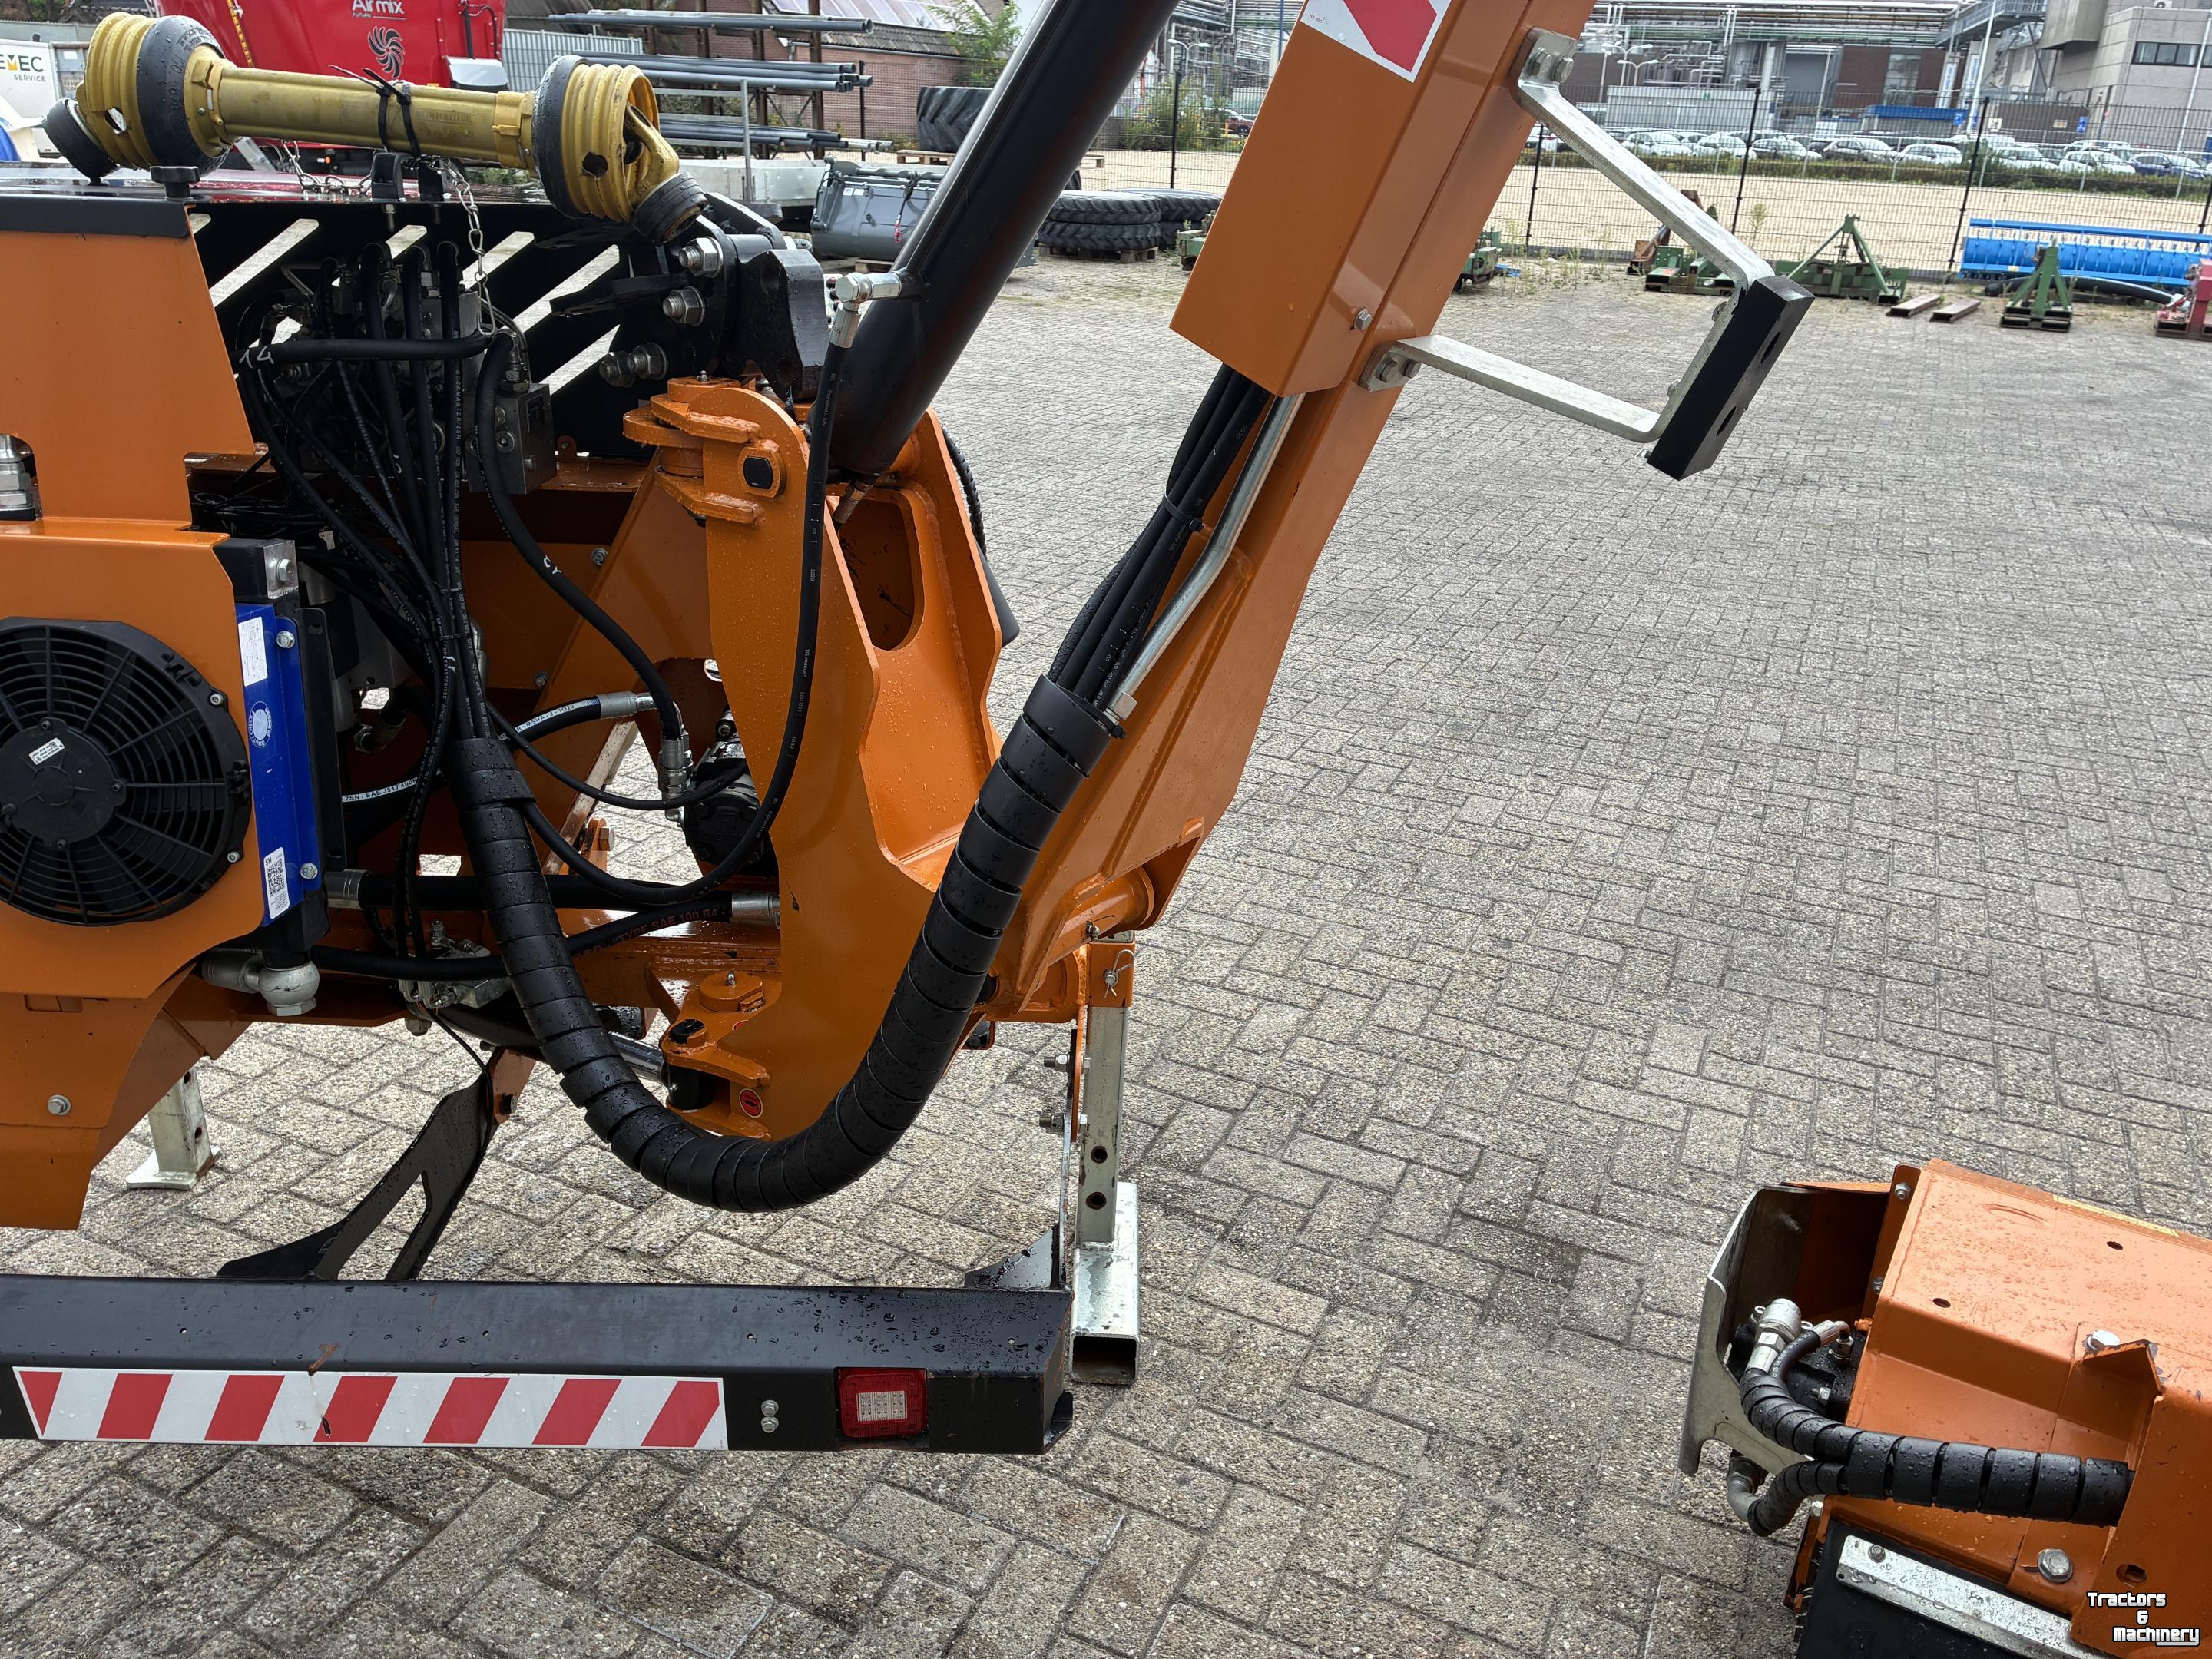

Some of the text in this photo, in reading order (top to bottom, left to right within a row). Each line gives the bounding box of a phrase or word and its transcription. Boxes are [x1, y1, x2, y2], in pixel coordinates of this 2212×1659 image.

[14, 74, 46, 82] SERVICE
[383, 785, 399, 794] J517
[651, 915, 676, 929] SAE
[679, 910, 700, 922] 100
